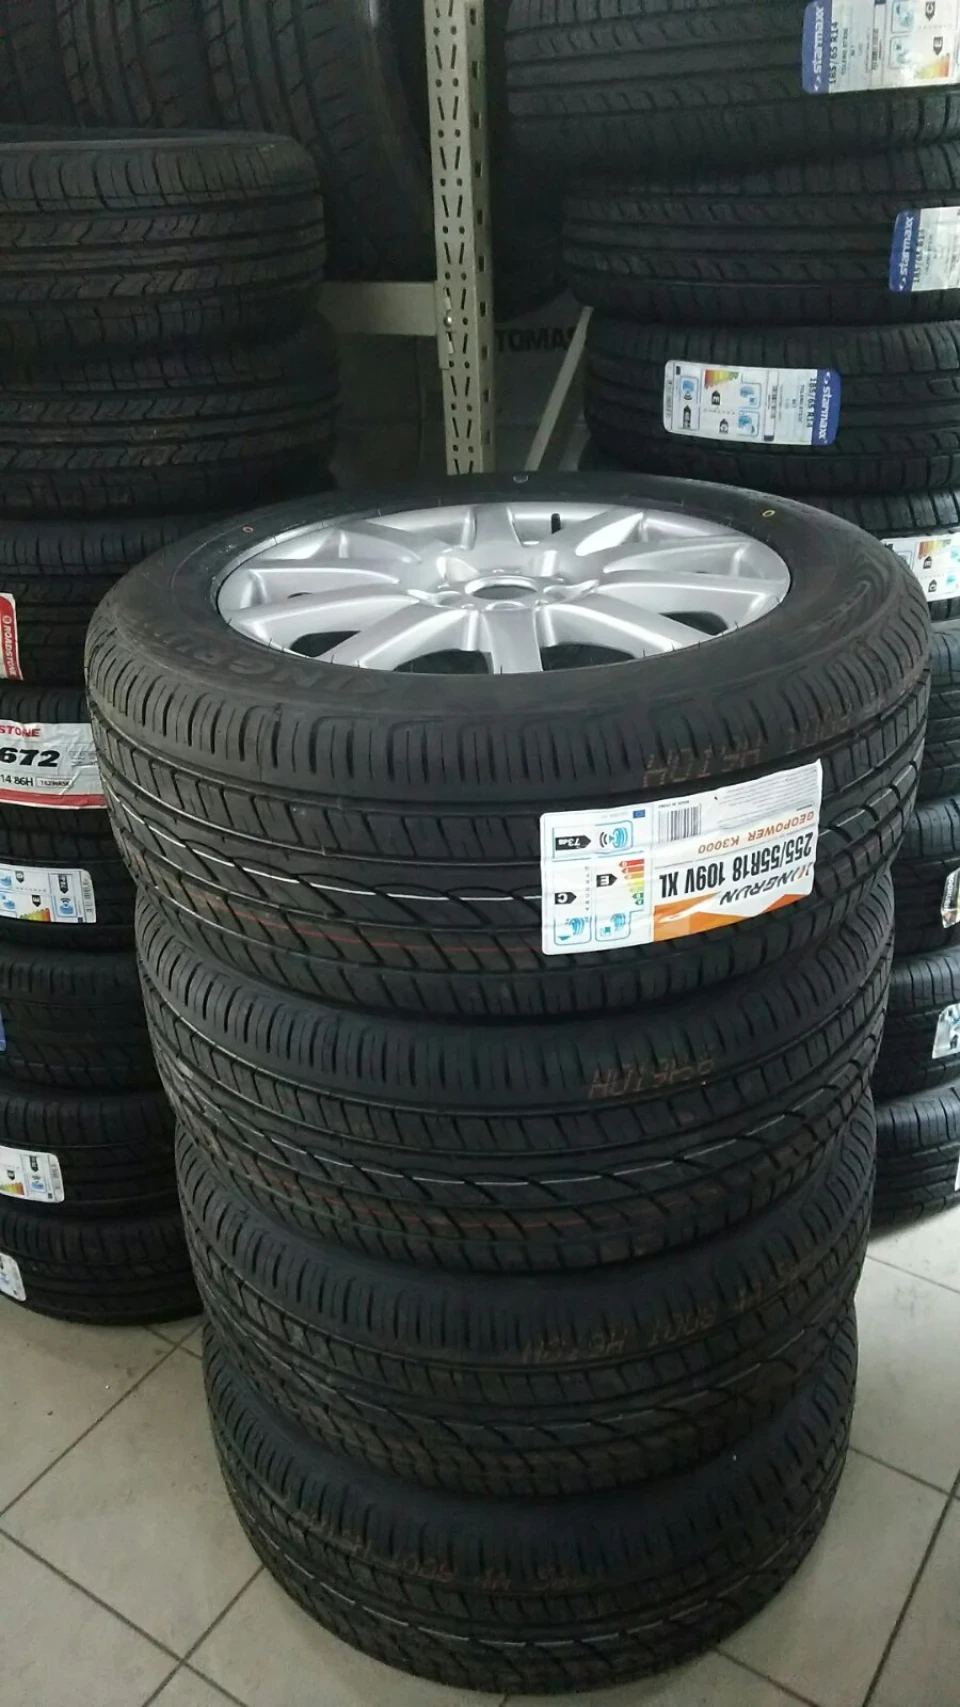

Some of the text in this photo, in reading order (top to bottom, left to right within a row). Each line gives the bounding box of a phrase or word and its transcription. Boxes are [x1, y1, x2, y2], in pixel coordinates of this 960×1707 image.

[812, 6, 824, 74] starmaxx
[899, 217, 913, 275] starmaxx
[819, 386, 832, 439] starmaxx
[3, 625, 16, 676] ROADSTONE
[14, 775, 34, 787] 86H
[698, 811, 815, 854] GEOPOWER K3000
[659, 832, 814, 898] 255/55R18 109V XL
